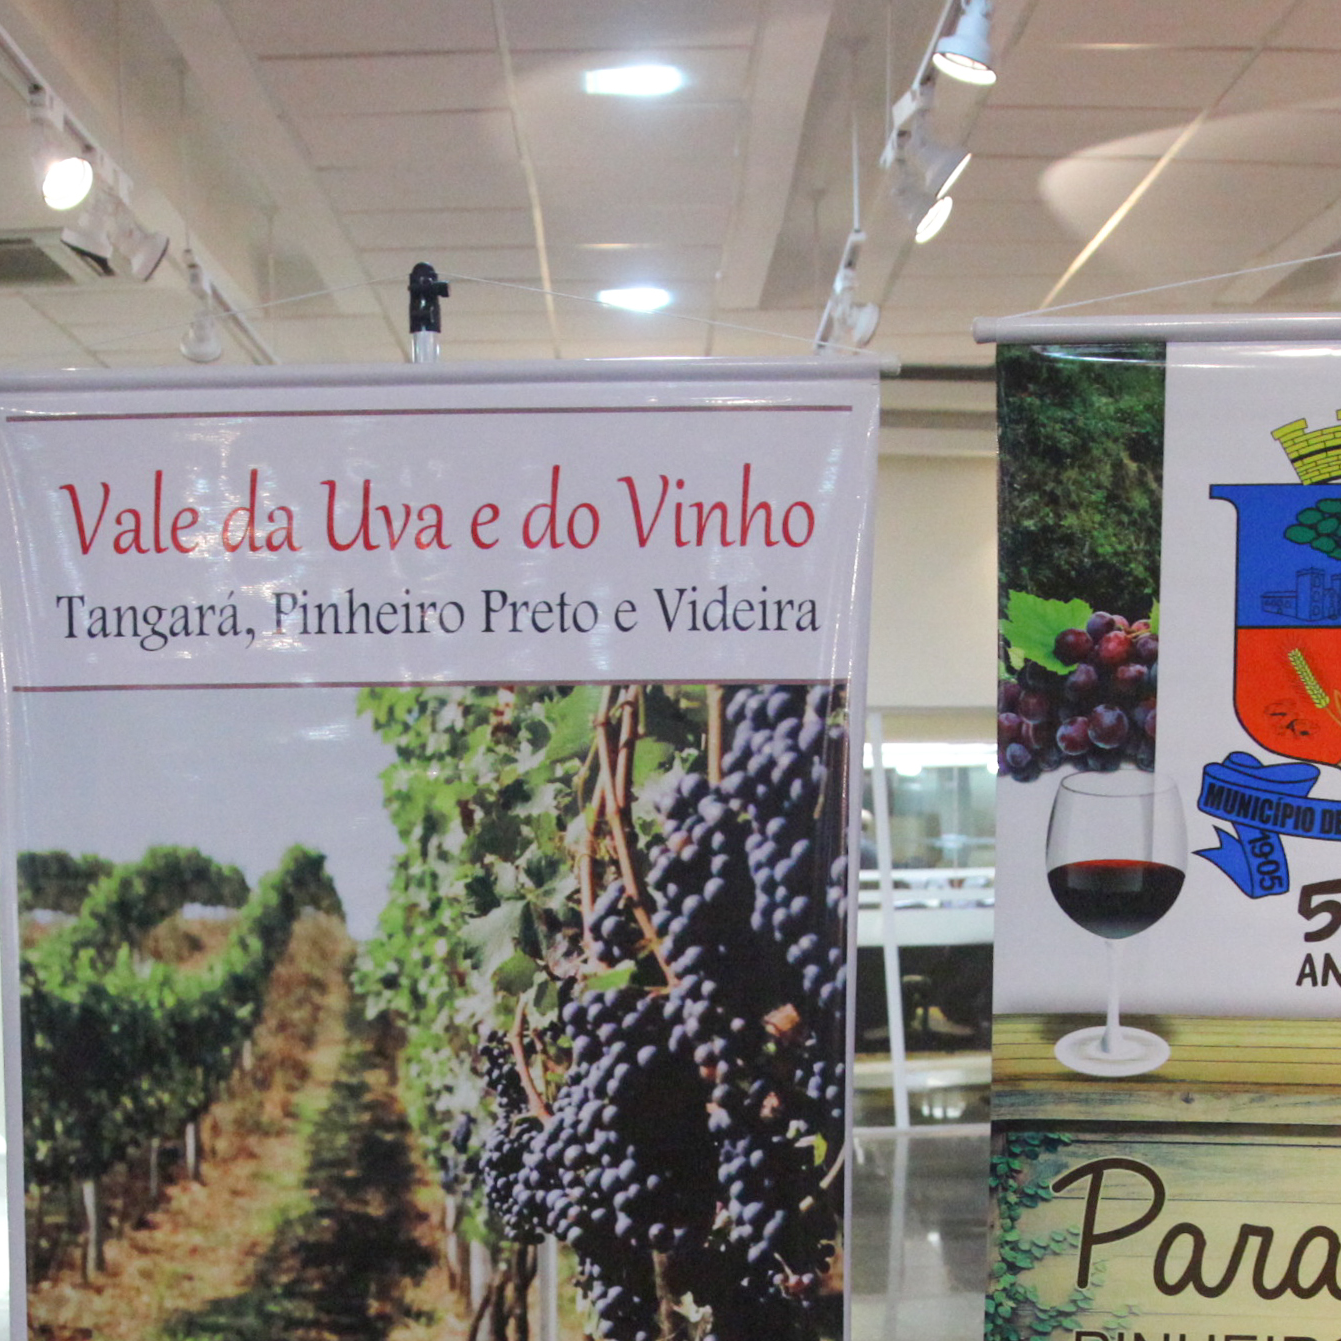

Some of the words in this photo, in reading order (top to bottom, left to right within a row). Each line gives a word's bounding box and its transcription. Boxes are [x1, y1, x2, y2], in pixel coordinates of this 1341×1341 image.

[59, 469, 199, 556] Vale
[222, 469, 302, 554] da
[320, 478, 453, 552] Uva
[470, 502, 501, 550] e
[521, 464, 601, 550] do
[617, 462, 816, 549] Vinho
[57, 593, 257, 652] Tangará,
[272, 588, 465, 640] Pinheiro
[480, 589, 599, 635] Preto
[614, 601, 639, 633] e
[653, 584, 821, 635] Videira
[1203, 782, 1311, 834] MUNICÍPIO
[1248, 830, 1284, 890] 1905
